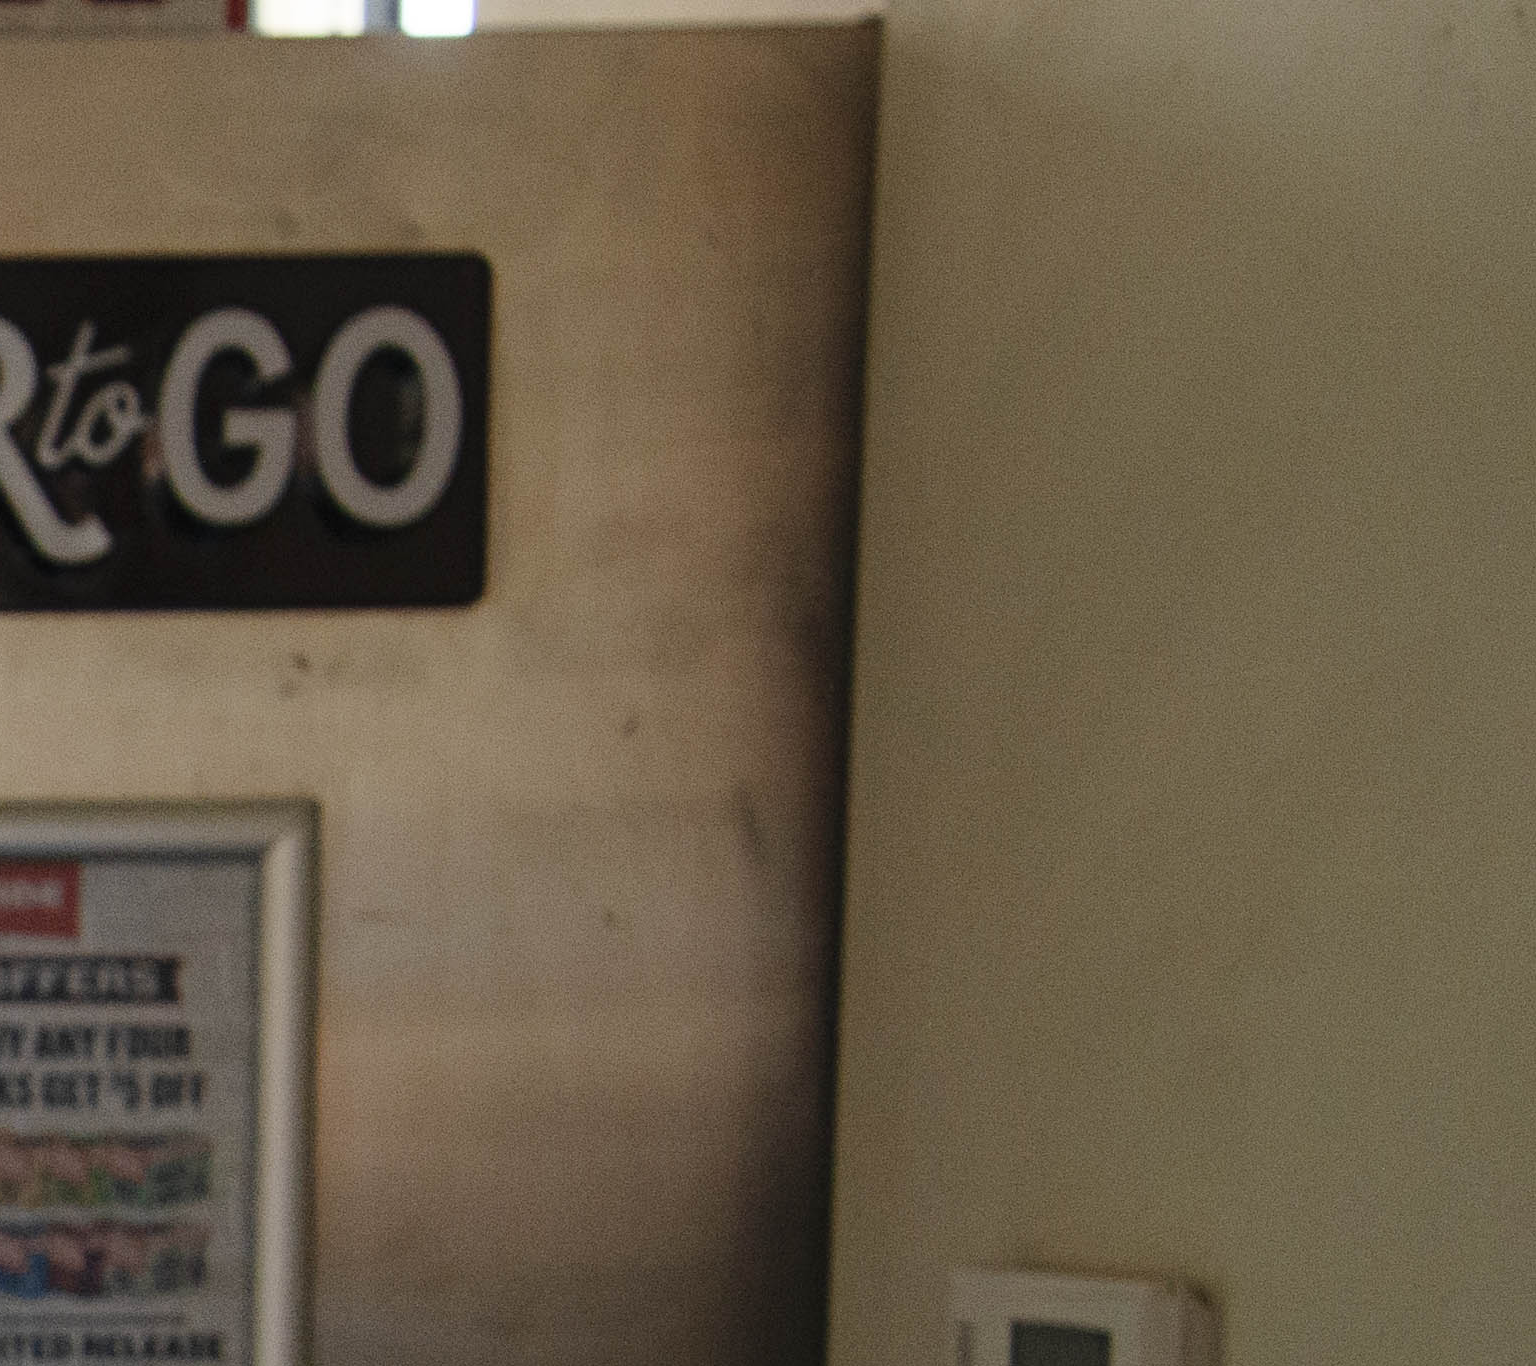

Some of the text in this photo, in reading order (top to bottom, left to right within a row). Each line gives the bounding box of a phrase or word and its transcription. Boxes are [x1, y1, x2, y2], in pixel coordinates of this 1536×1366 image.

[38, 324, 143, 469] to
[159, 305, 462, 527] GO
[37, 1026, 94, 1059] ANY
[106, 1025, 189, 1057] FOUR
[42, 1074, 99, 1107] GET
[151, 1073, 208, 1106] OFF
[83, 1332, 225, 1361] RELEASE
